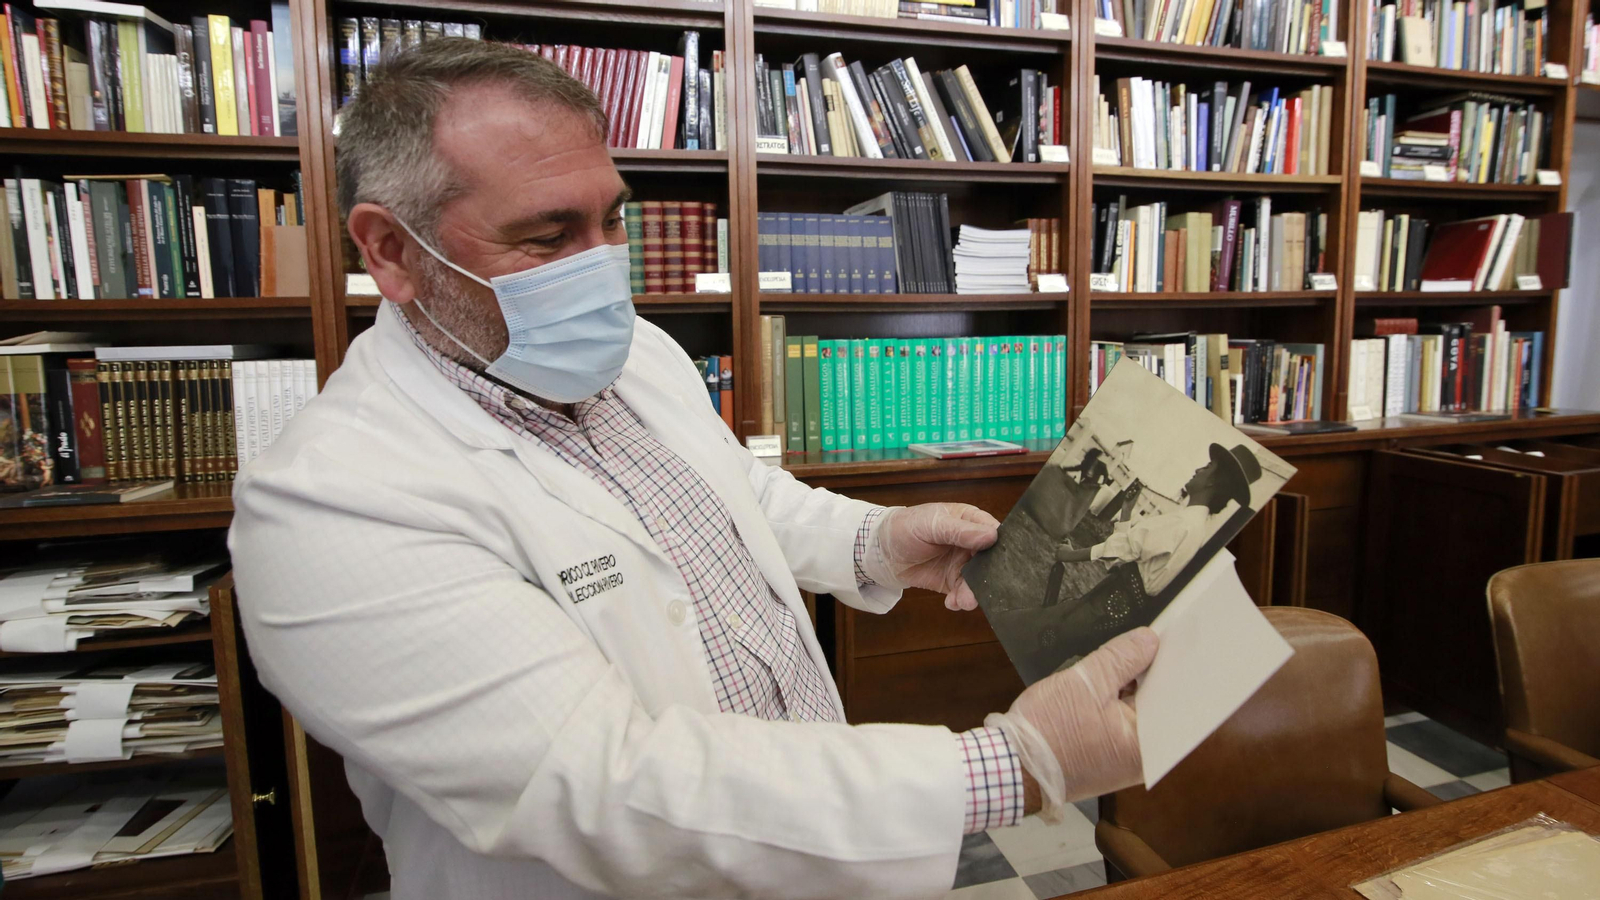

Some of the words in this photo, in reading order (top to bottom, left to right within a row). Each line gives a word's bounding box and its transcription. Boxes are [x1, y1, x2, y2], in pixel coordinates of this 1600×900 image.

[908, 97, 922, 116] Life
[1226, 205, 1238, 242] MURILLO
[1116, 247, 1122, 255] EL
[1449, 338, 1459, 371] GOYA
[248, 396, 256, 436] FLORENCIA
[273, 395, 281, 430] VATICANO
[58, 432, 74, 452] Prado
[590, 554, 616, 574] RIVERO
